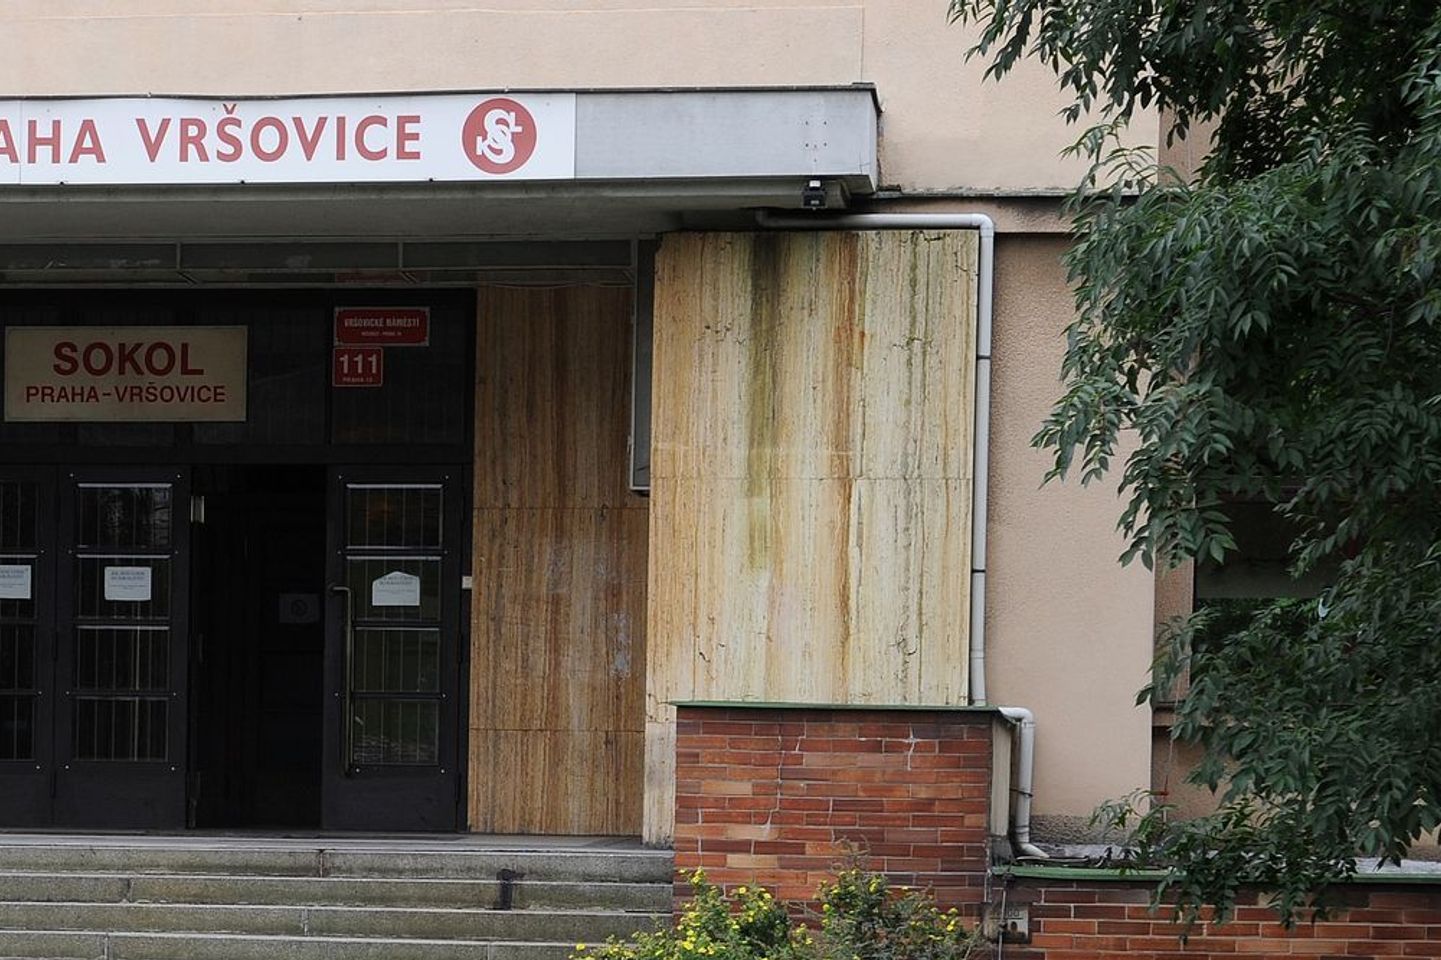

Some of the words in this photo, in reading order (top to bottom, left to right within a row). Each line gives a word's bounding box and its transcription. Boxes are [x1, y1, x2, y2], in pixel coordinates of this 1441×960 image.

[135, 103, 422, 163] VRŠOVICE
[52, 341, 205, 377] SOKOL
[339, 354, 377, 374] 111
